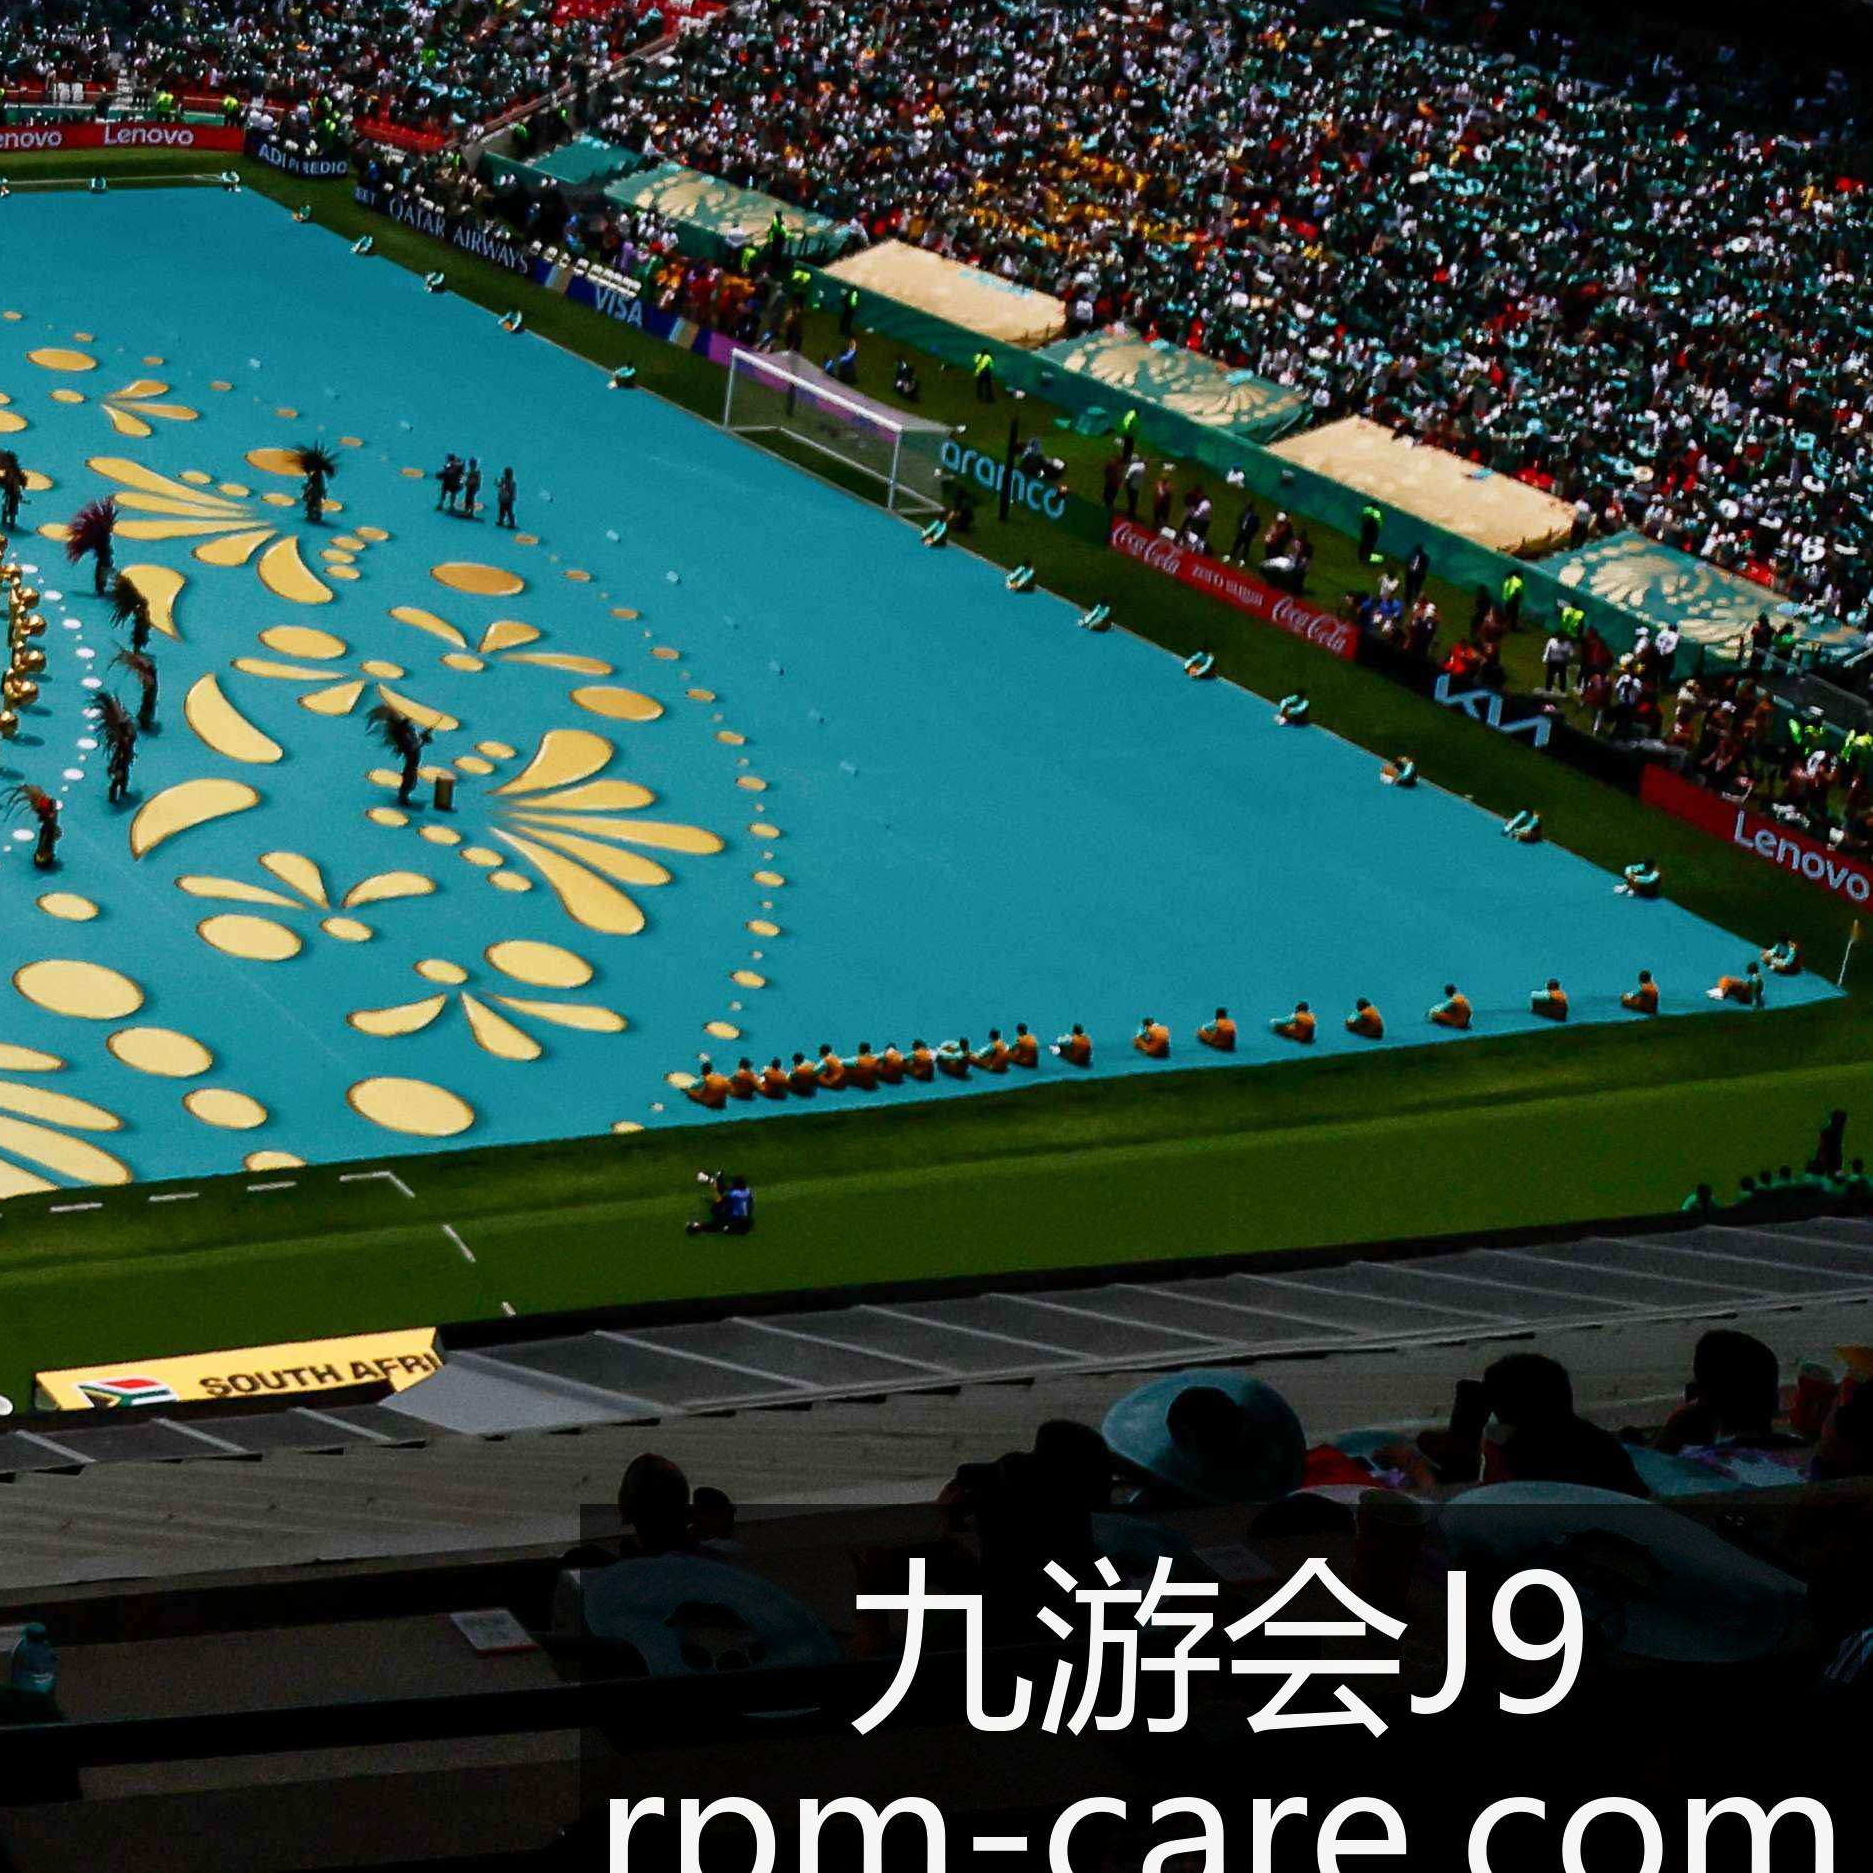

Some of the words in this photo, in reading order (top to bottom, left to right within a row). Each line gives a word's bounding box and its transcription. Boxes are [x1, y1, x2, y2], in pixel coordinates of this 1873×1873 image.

[103, 122, 195, 147] Lenovo
[258, 146, 288, 169] ADI
[389, 195, 447, 239] QATAR
[453, 226, 529, 277] AIRWAYS
[594, 284, 645, 329] VISA
[940, 436, 1067, 520] aramco
[1731, 806, 1872, 906] Lenovo
[199, 1363, 344, 1399] SOUTH
[350, 1352, 443, 1381] AFRI
